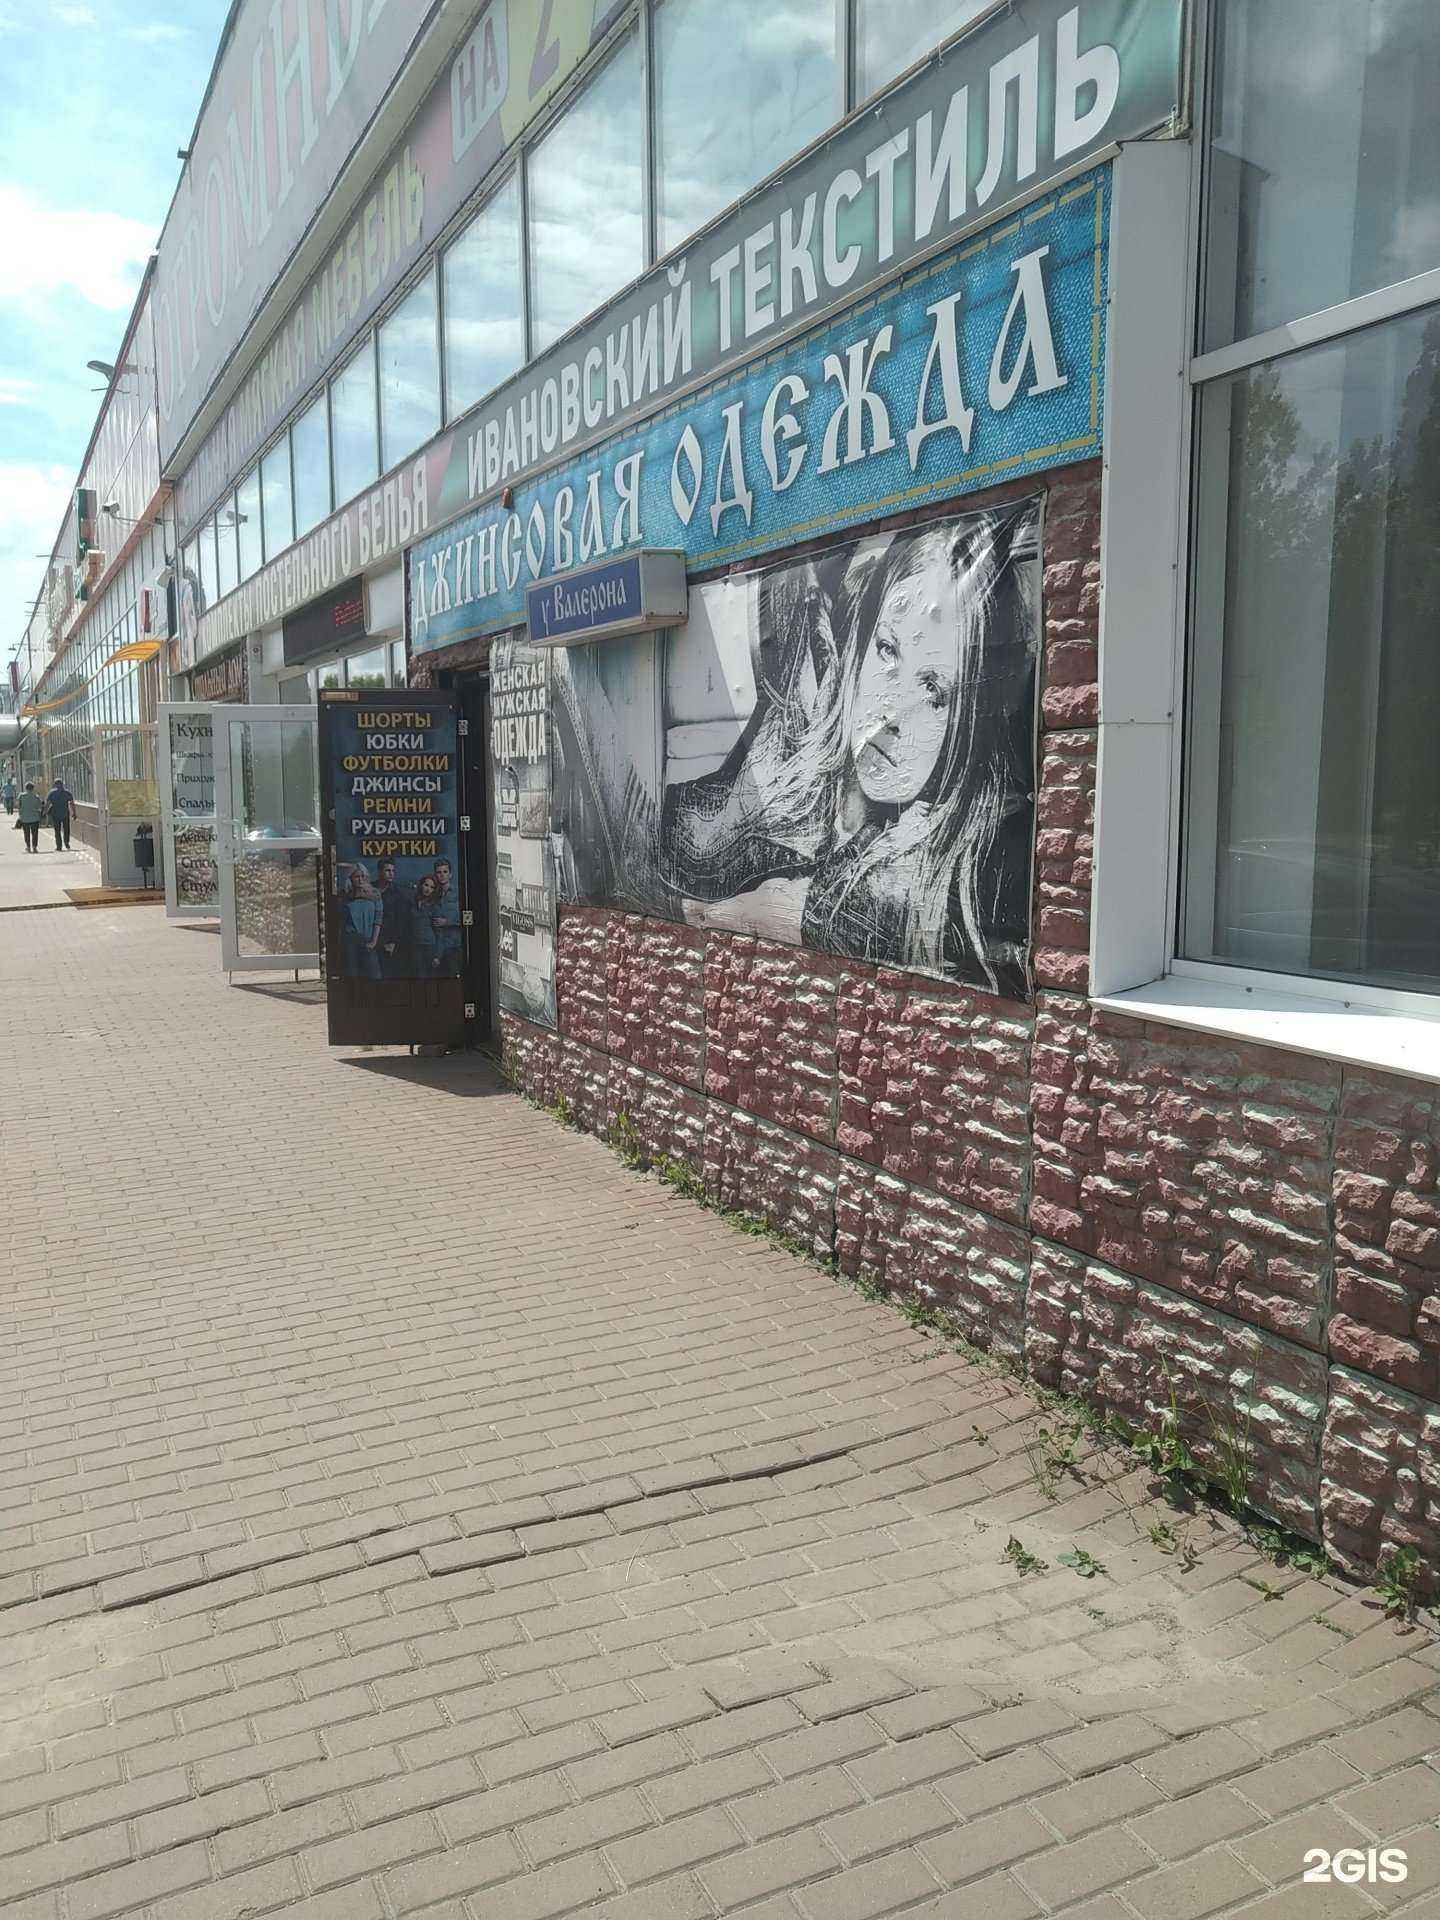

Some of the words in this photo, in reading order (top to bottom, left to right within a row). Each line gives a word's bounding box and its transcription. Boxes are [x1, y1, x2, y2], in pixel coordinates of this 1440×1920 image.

[312, 146, 425, 366] МЕБЕЛЬ
[458, 15, 500, 139] НА
[154, 0, 388, 422] ОГРОМН
[256, 512, 351, 624] ПОСТЕЛЬНОГО
[358, 454, 428, 566] БЕЛЬЯ
[467, 264, 692, 499] ИВАНОВСКИЙ
[709, 5, 1120, 353] ТЕКСТИЛЬ
[411, 450, 645, 636] ДЖИНСОВАЯ
[669, 244, 1068, 539] ОДЕЖДА
[493, 661, 546, 693] ЖЕНСКАЯ
[493, 687, 546, 717] МУЖСКАЯ
[357, 712, 431, 728] ШОРТЫ
[177, 723, 213, 740] Кухн
[493, 713, 546, 766] ОДЕЖДА
[366, 734, 424, 750] ЮБКИ
[343, 755, 449, 771] ФУТБОЛКИ
[177, 773, 215, 784] Прихож
[351, 776, 441, 795] ДЖИНСЫ
[363, 798, 432, 814] РЕМНИ
[351, 819, 446, 835] РУБАШКИ
[362, 840, 436, 856] КУРТКИ
[182, 857, 218, 868] Стол
[182, 880, 218, 895] Стул
